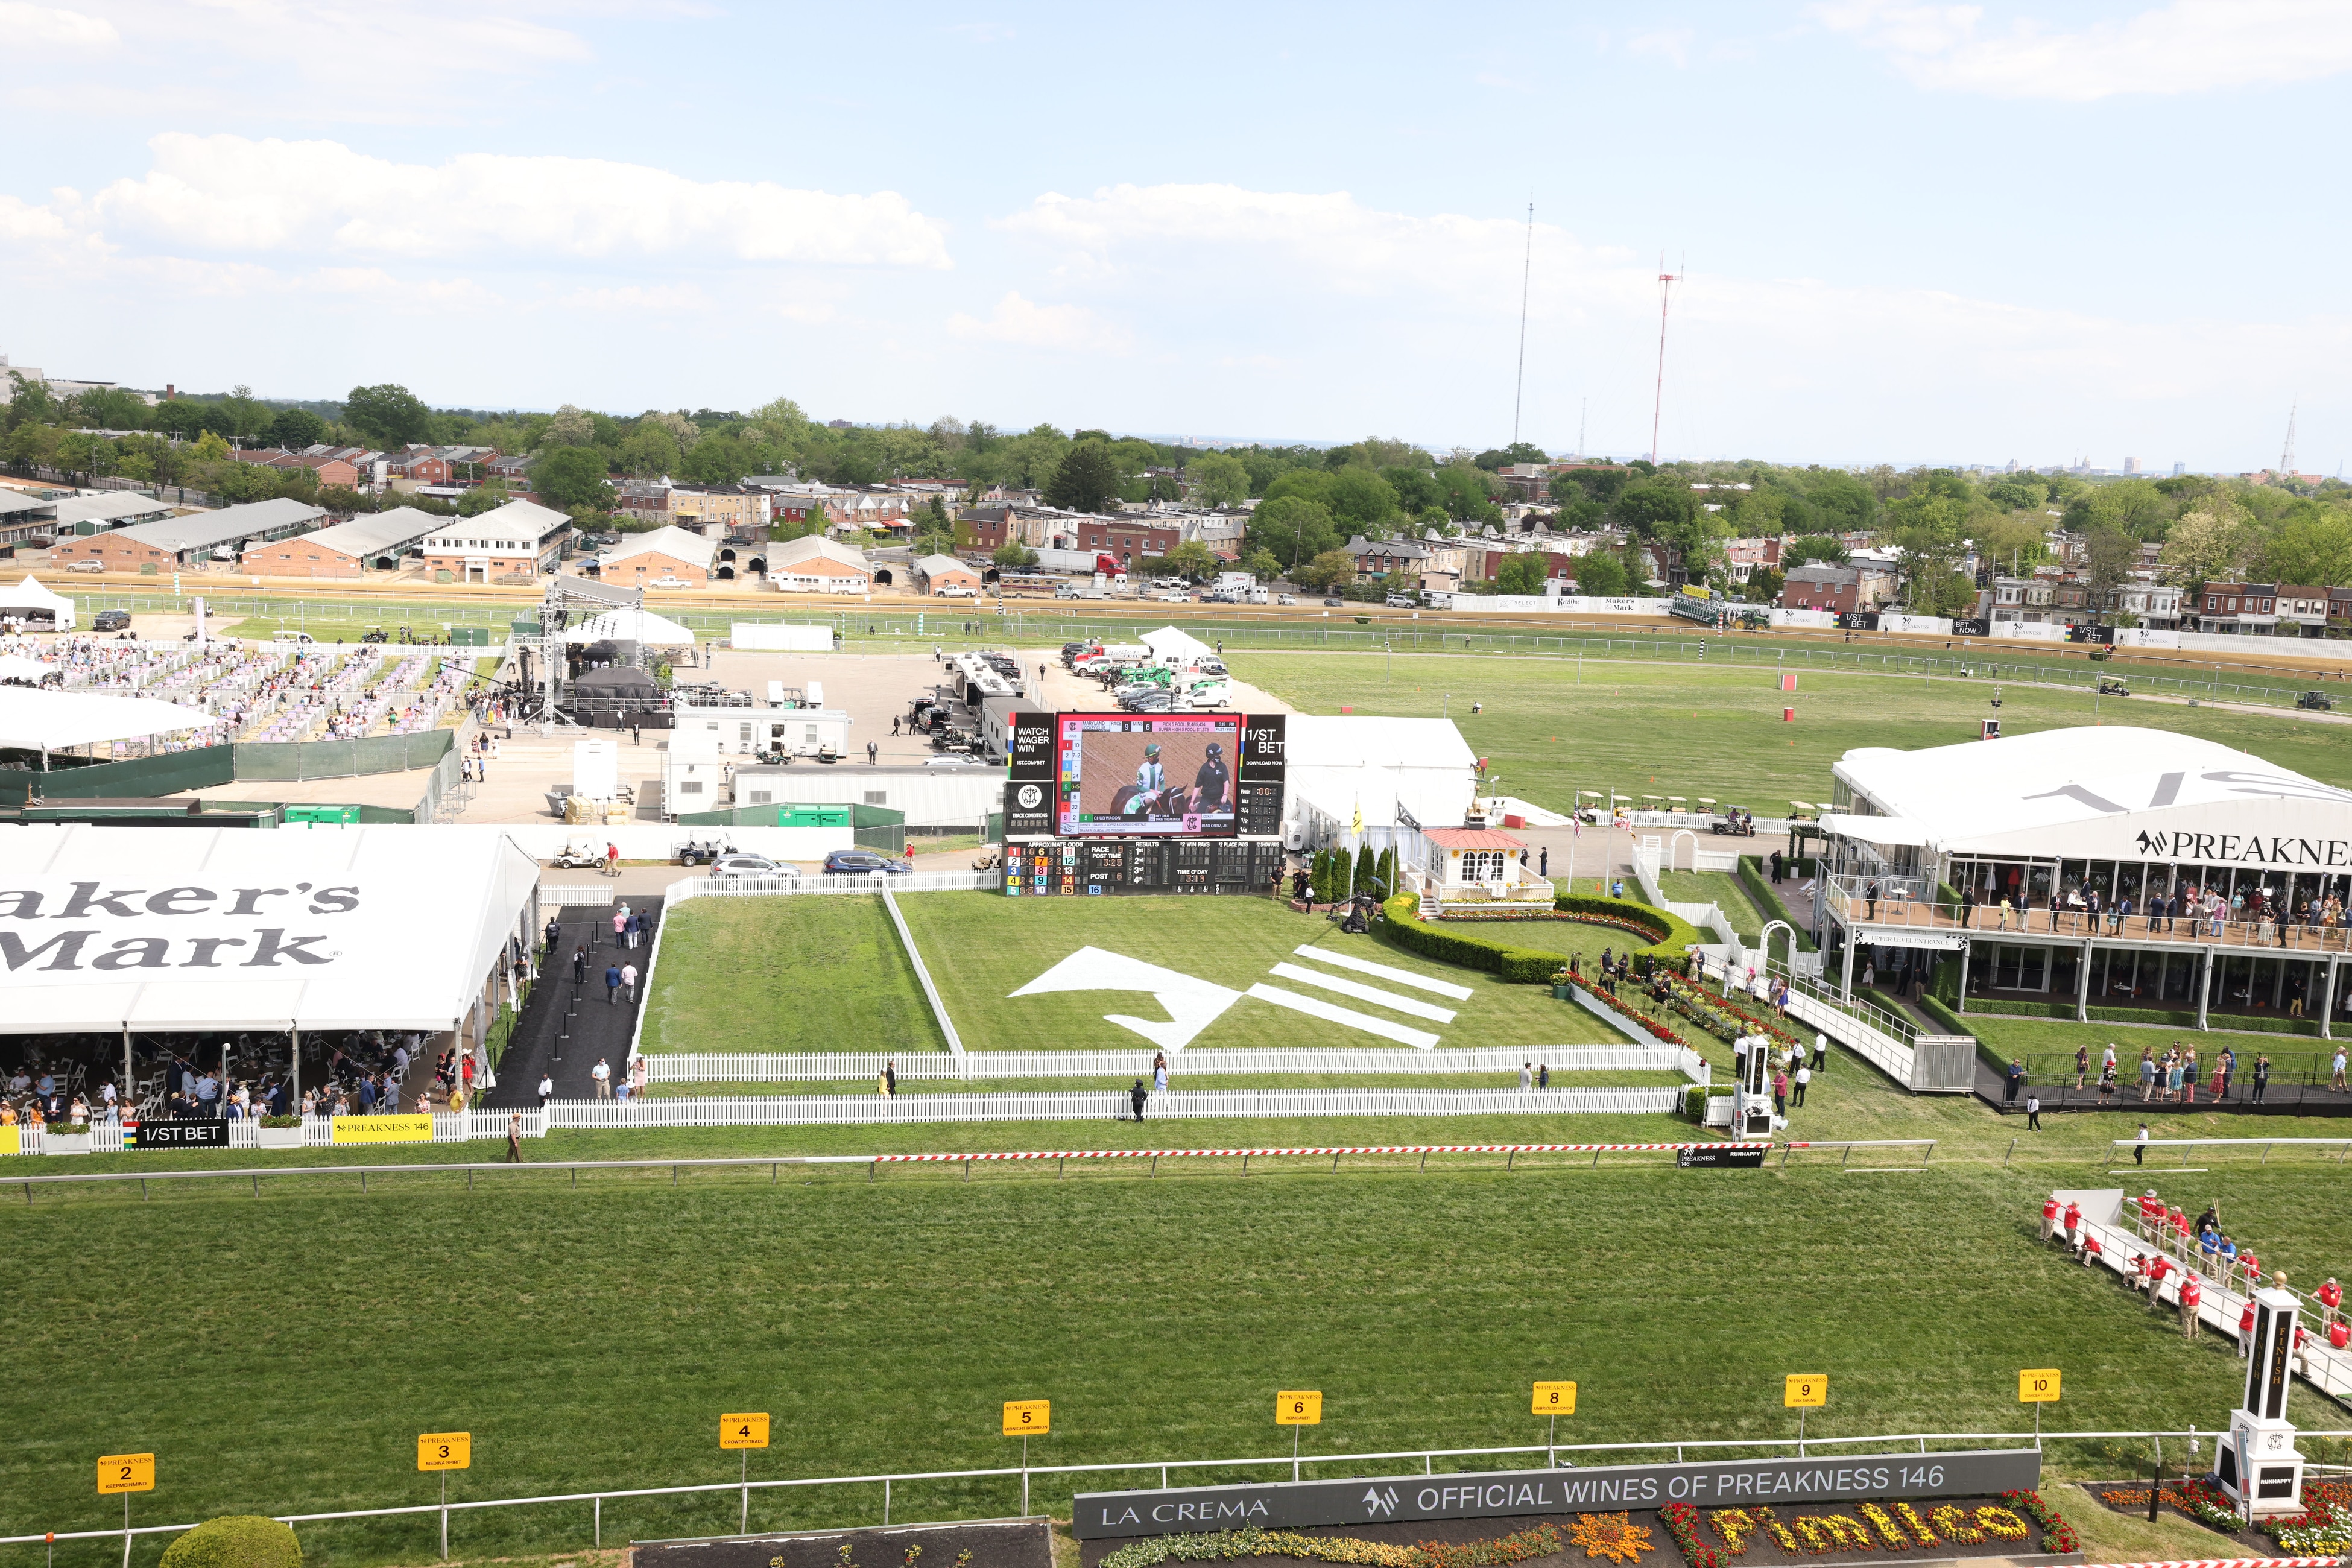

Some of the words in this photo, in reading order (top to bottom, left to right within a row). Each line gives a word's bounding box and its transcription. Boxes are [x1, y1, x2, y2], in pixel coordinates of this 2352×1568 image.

[1686, 587, 1703, 596] PREAKNESS
[1247, 729, 1276, 741] 1/ST
[1258, 741, 1284, 753] BET
[2170, 832, 2352, 867] PREAKNE
[347, 1123, 410, 1133] PREAKNESS
[413, 1122, 429, 1131] 146
[143, 1127, 182, 1142] 1/ST
[185, 1126, 220, 1140] BET
[2254, 1321, 2265, 1380] FINISH
[2273, 1328, 2285, 1384] FINISH
[1802, 1385, 1810, 1396] 9
[2033, 1380, 2047, 1391] 10
[1550, 1392, 1559, 1403] 8
[1294, 1402, 1303, 1413] 6
[1022, 1412, 1031, 1423] 5
[739, 1425, 750, 1437] 4
[439, 1445, 449, 1458] 3
[108, 1457, 152, 1466] PREAKNESS
[121, 1467, 131, 1480] 2
[1417, 1483, 1553, 1511] OFFICIAL
[1565, 1477, 1658, 1503] WINES
[1669, 1474, 1707, 1497] OF
[1717, 1468, 1889, 1496] PREAKNESS
[1900, 1465, 1944, 1488] 146
[1102, 1507, 1141, 1527] LA
[1151, 1499, 1267, 1524] CREMA
[1707, 1502, 2031, 1556] Pimlico
